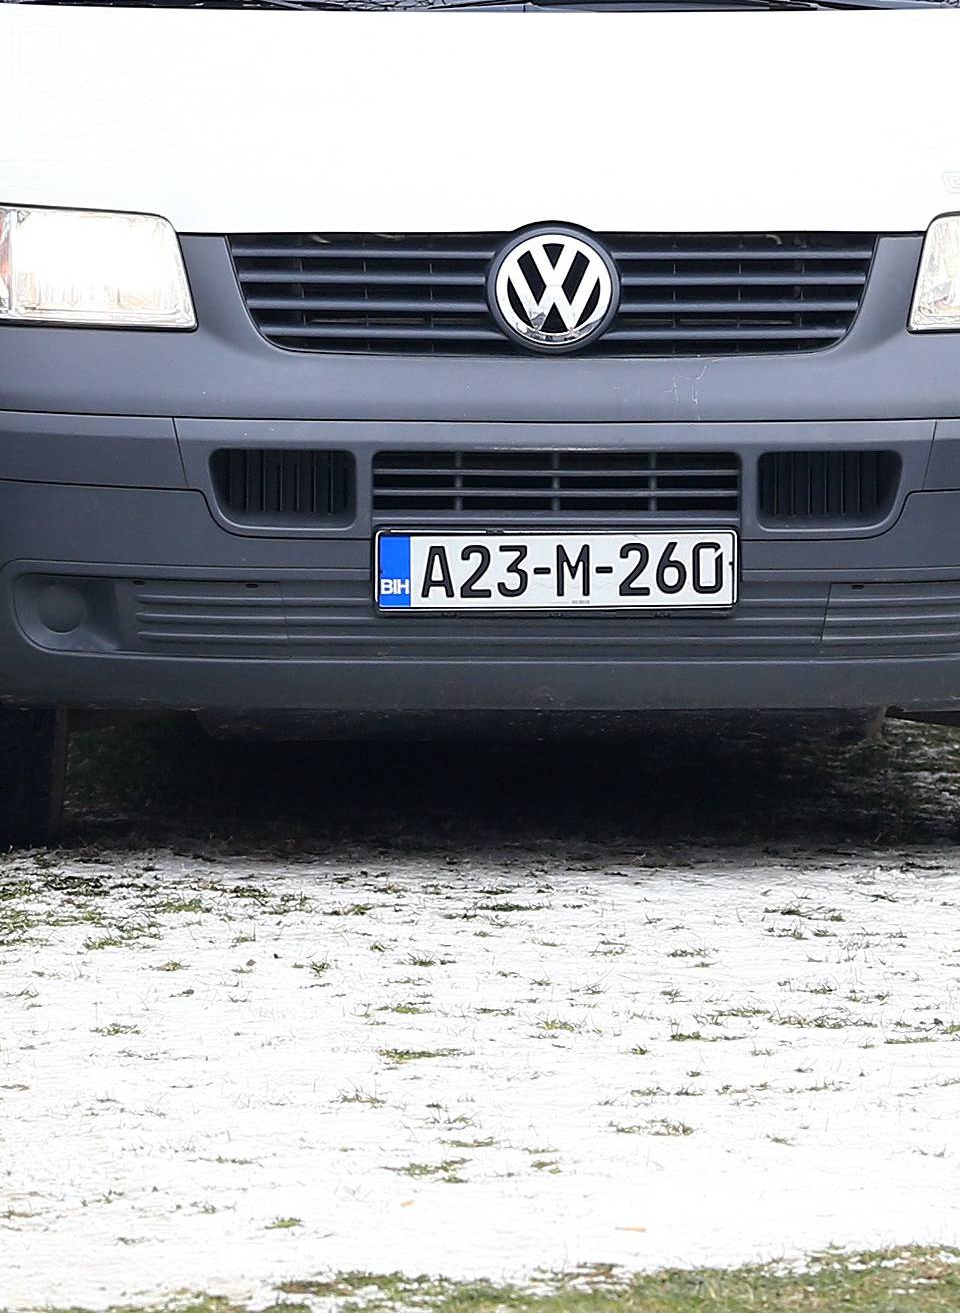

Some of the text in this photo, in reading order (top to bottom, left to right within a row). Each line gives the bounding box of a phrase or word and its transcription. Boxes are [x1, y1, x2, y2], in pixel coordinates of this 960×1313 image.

[497, 235, 612, 343] VW
[380, 577, 410, 595] BIH
[420, 541, 724, 598] A23-M-260
